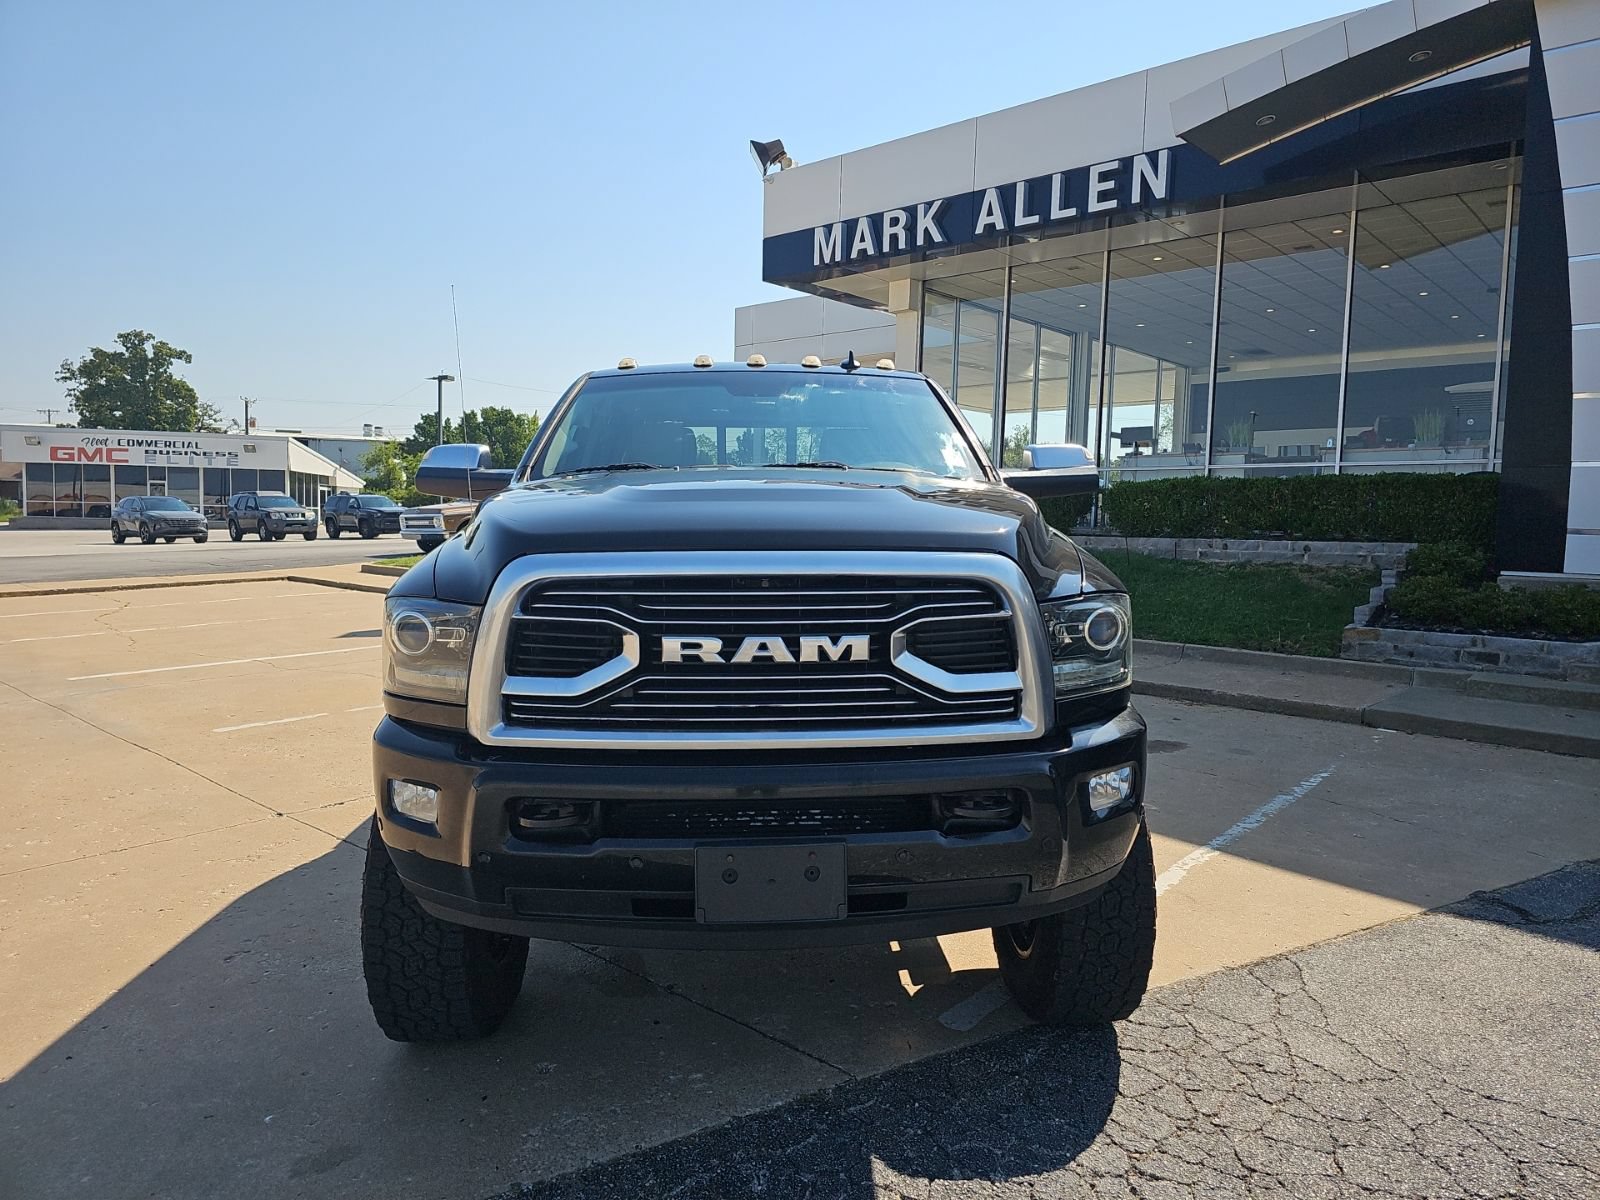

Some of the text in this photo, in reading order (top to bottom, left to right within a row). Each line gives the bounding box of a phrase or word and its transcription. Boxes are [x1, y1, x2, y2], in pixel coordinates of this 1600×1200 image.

[812, 148, 1172, 267] MARK ALLEN
[117, 438, 203, 450] COMMERCIAL
[50, 446, 129, 464] GMC
[144, 449, 239, 457] BUSINESS
[144, 454, 239, 466] ELITE
[661, 634, 870, 663] RAM
